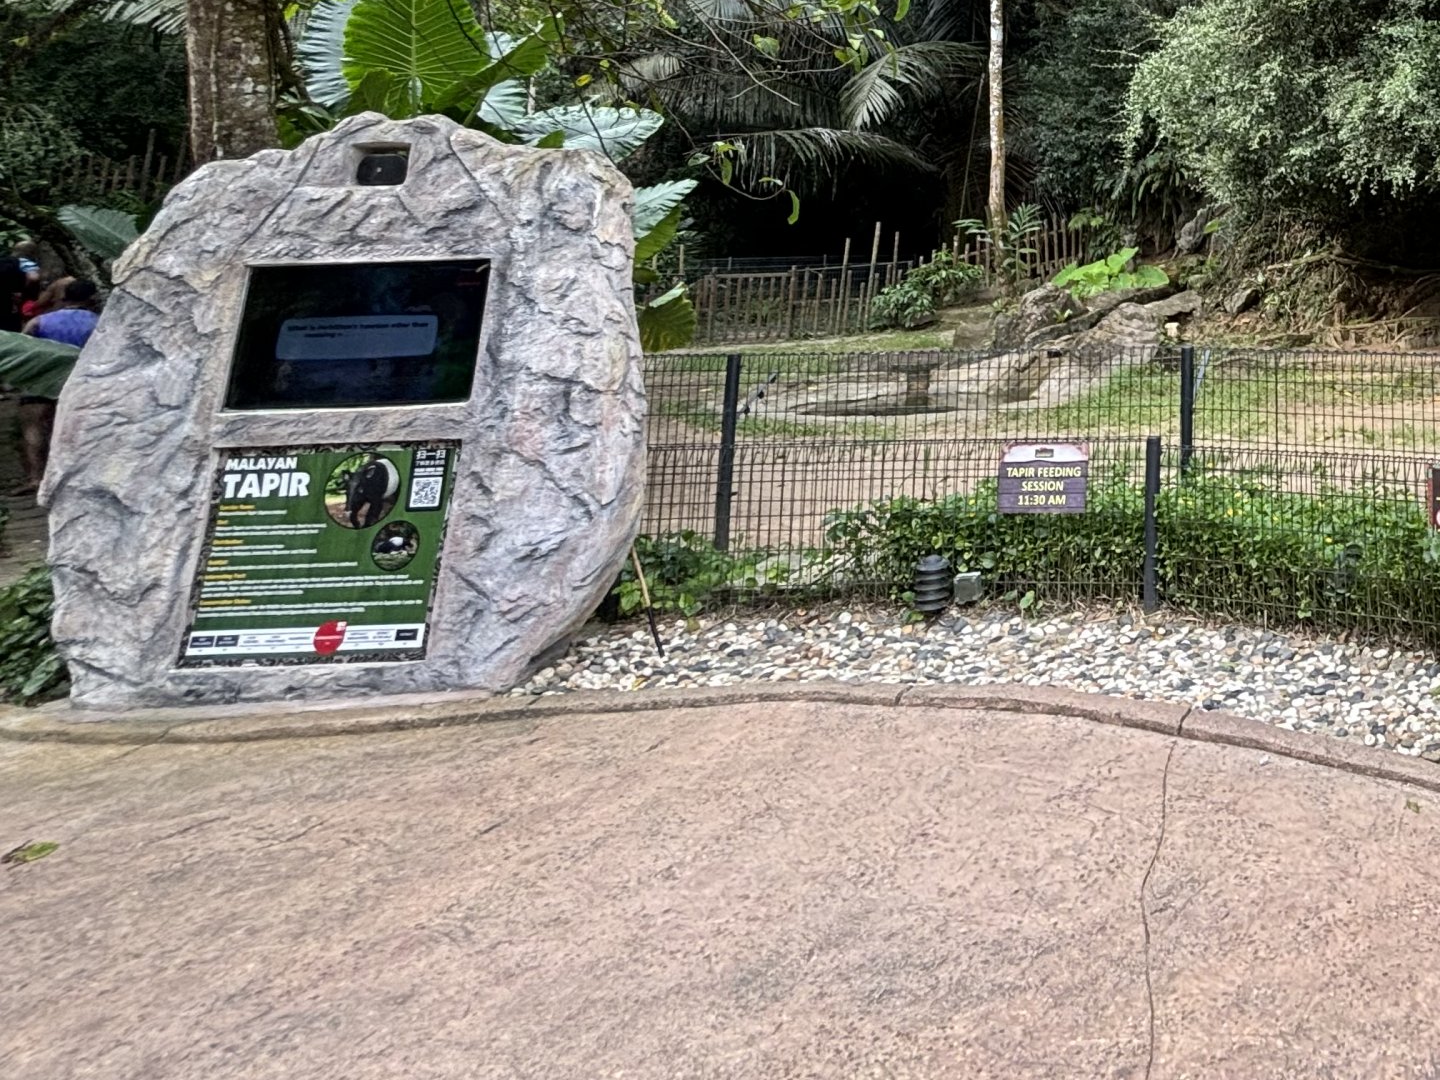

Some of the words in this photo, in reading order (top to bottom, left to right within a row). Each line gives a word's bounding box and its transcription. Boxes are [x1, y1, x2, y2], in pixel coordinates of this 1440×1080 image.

[225, 457, 298, 470] MALAYAN
[1006, 467, 1035, 477] TAPIR
[1037, 466, 1082, 478] FEEDING
[223, 472, 311, 498] TAPIR
[1021, 481, 1064, 491] SESSION
[1018, 494, 1046, 505] 11:30
[1047, 495, 1066, 505] AM
